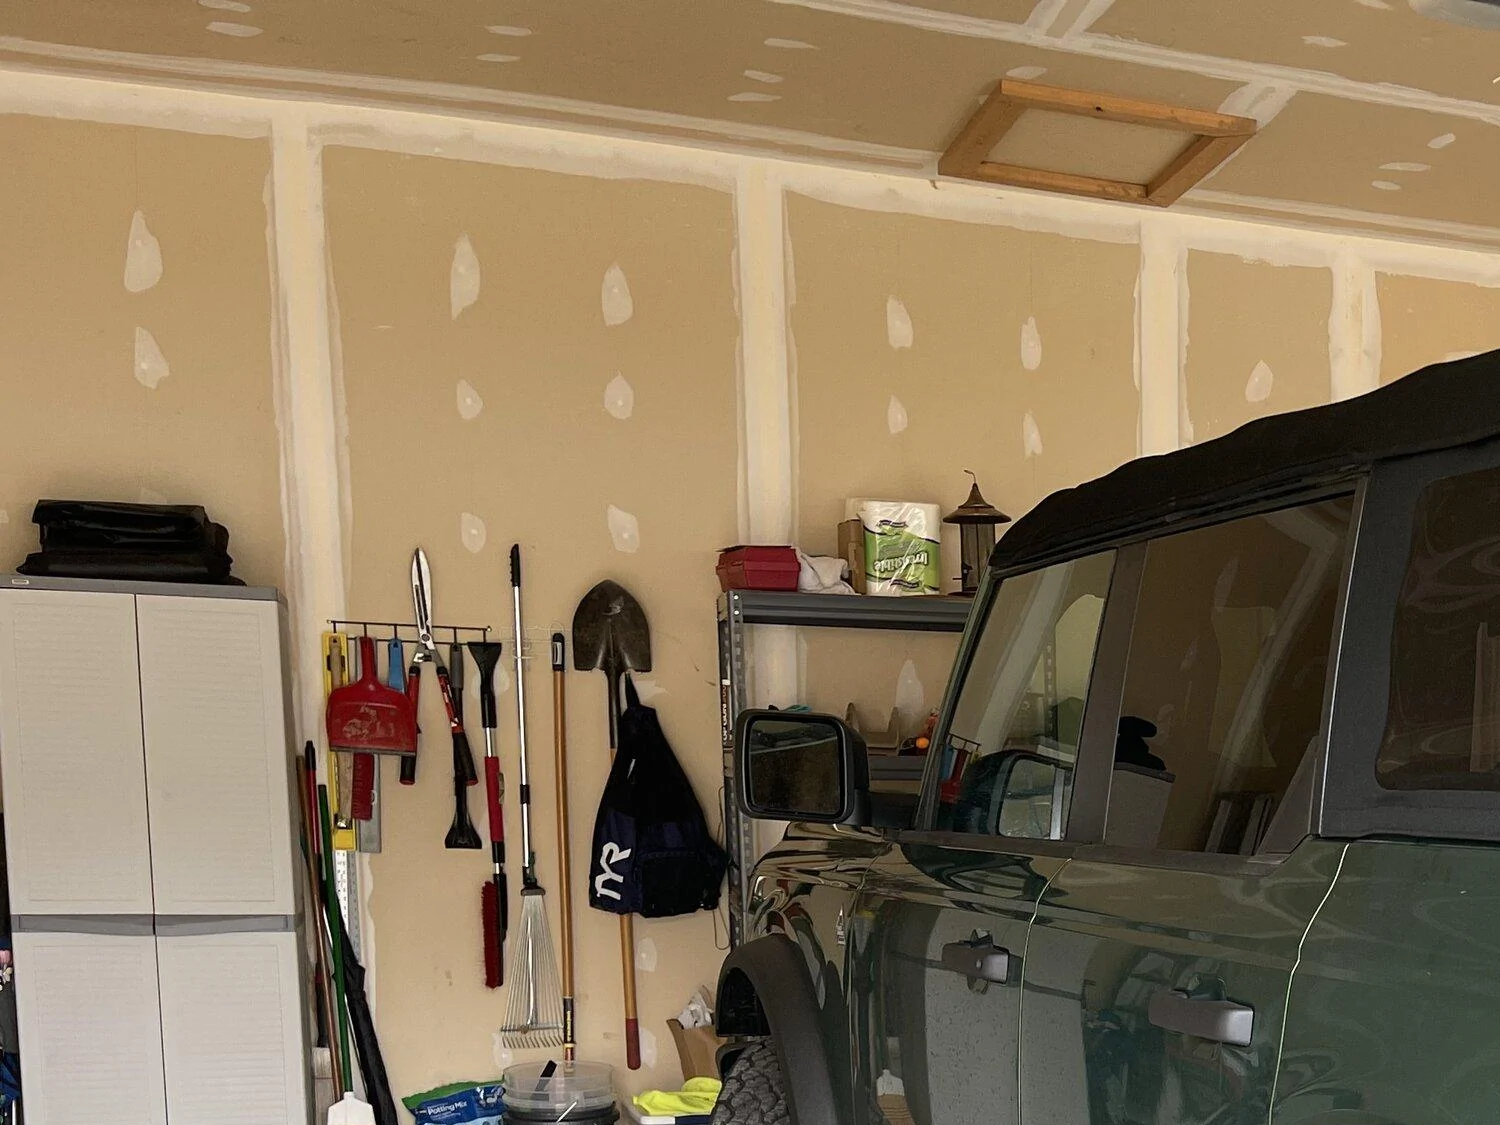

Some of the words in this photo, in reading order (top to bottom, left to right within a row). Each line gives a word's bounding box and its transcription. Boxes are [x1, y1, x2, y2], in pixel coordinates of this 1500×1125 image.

[595, 842, 632, 900] TYR
[427, 1103, 455, 1116] Potting
[455, 1100, 468, 1109] Mix
